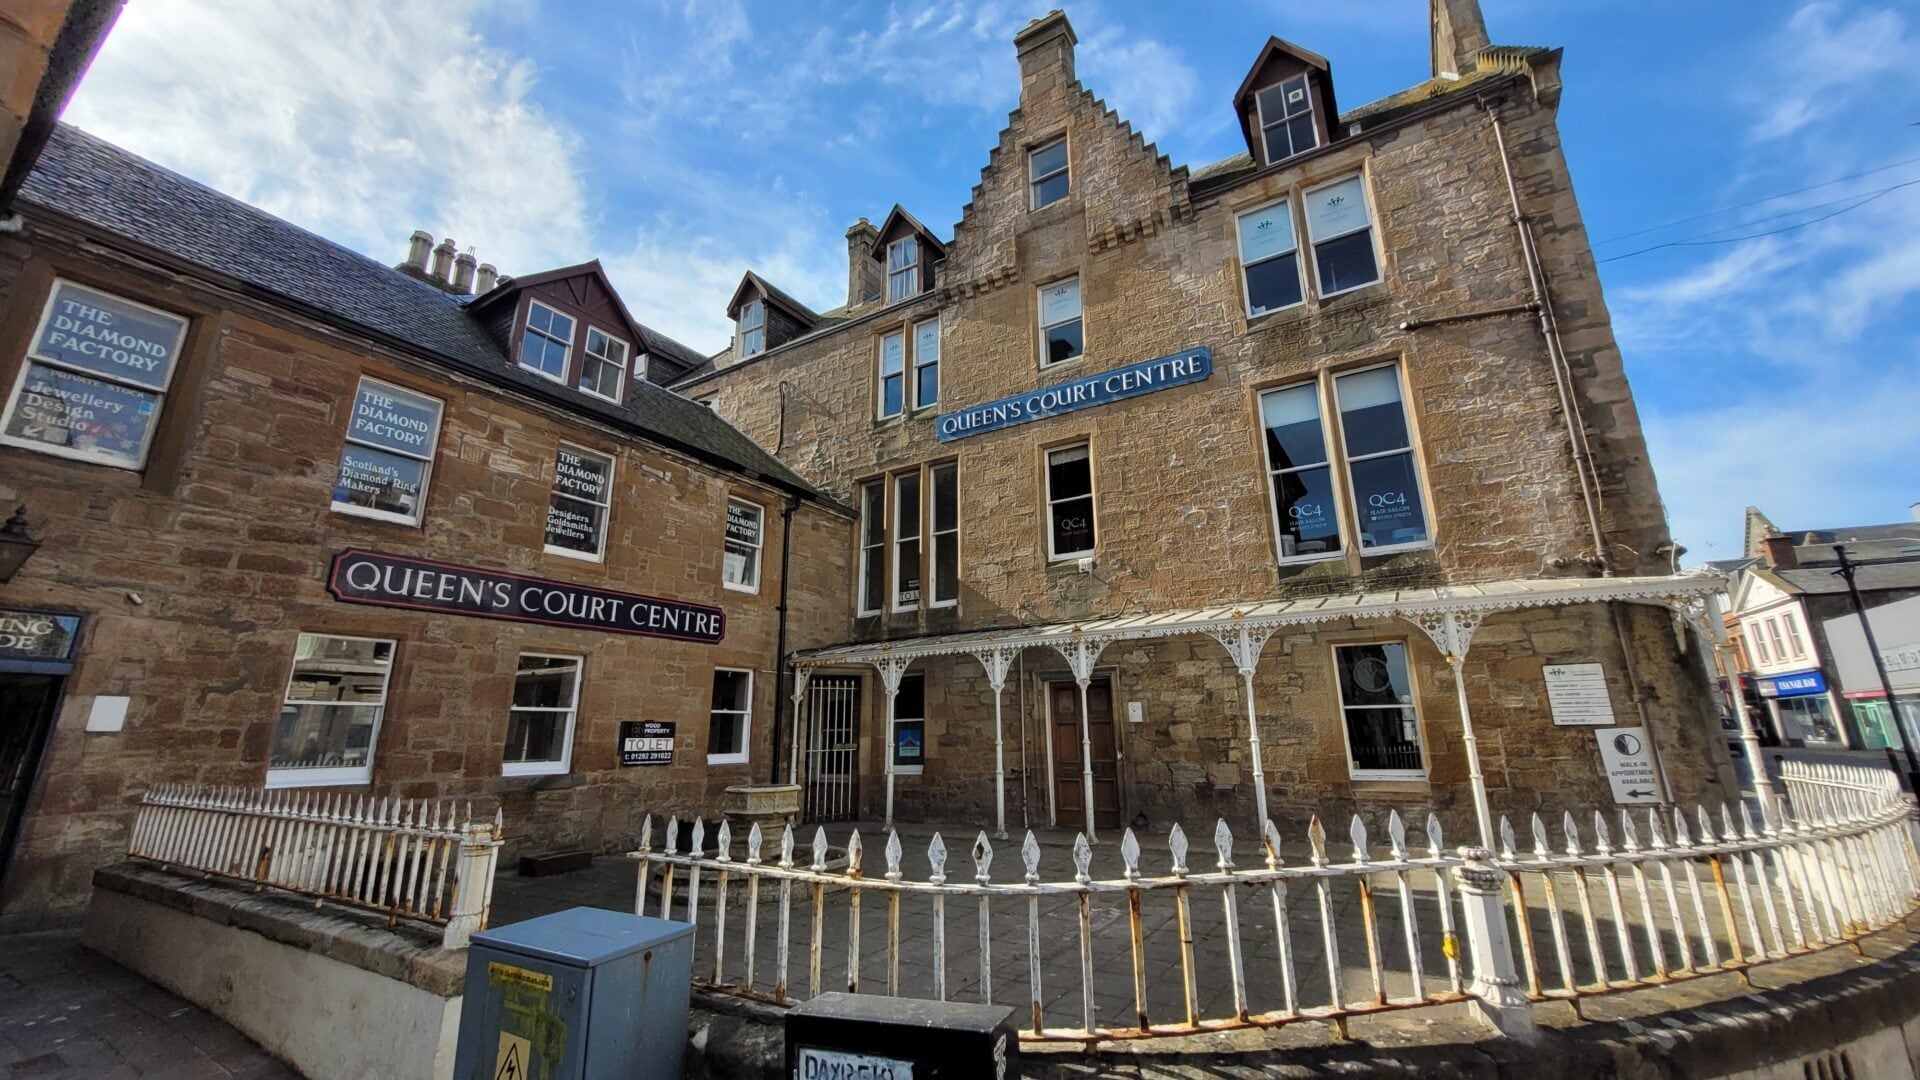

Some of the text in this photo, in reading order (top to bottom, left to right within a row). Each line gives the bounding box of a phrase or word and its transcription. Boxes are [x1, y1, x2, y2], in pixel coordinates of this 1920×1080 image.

[62, 299, 113, 326] THE
[54, 315, 167, 358] DIAMOND
[48, 332, 160, 372] FACTORY
[30, 380, 124, 413] Jewellery
[363, 391, 393, 410] THE
[942, 354, 1203, 434] QUEEN'S COURT CENTRE
[25, 394, 95, 422] Design
[20, 406, 87, 432] Studio
[358, 404, 428, 433] DIAMOND
[355, 418, 424, 446] FACTORY
[343, 455, 399, 477] Scotland's
[560, 452, 580, 466] THE
[341, 466, 416, 493] Diamond Ring
[557, 463, 605, 484] DIAMOND
[338, 478, 381, 495] Makers
[556, 475, 602, 495] FACTORY
[1369, 492, 1406, 507] QC4
[548, 506, 589, 523] Designers
[728, 505, 742, 516] THE
[1288, 504, 1322, 518] QC4
[547, 515, 594, 533] Goldsmiths
[726, 524, 756, 538] FACTORY
[727, 513, 758, 530] DIAMOND
[1061, 517, 1087, 530] QC4
[545, 524, 585, 540] Jewellers
[346, 560, 721, 636] QUEEN'S COURT CENTRE
[628, 738, 671, 750] TO LET
